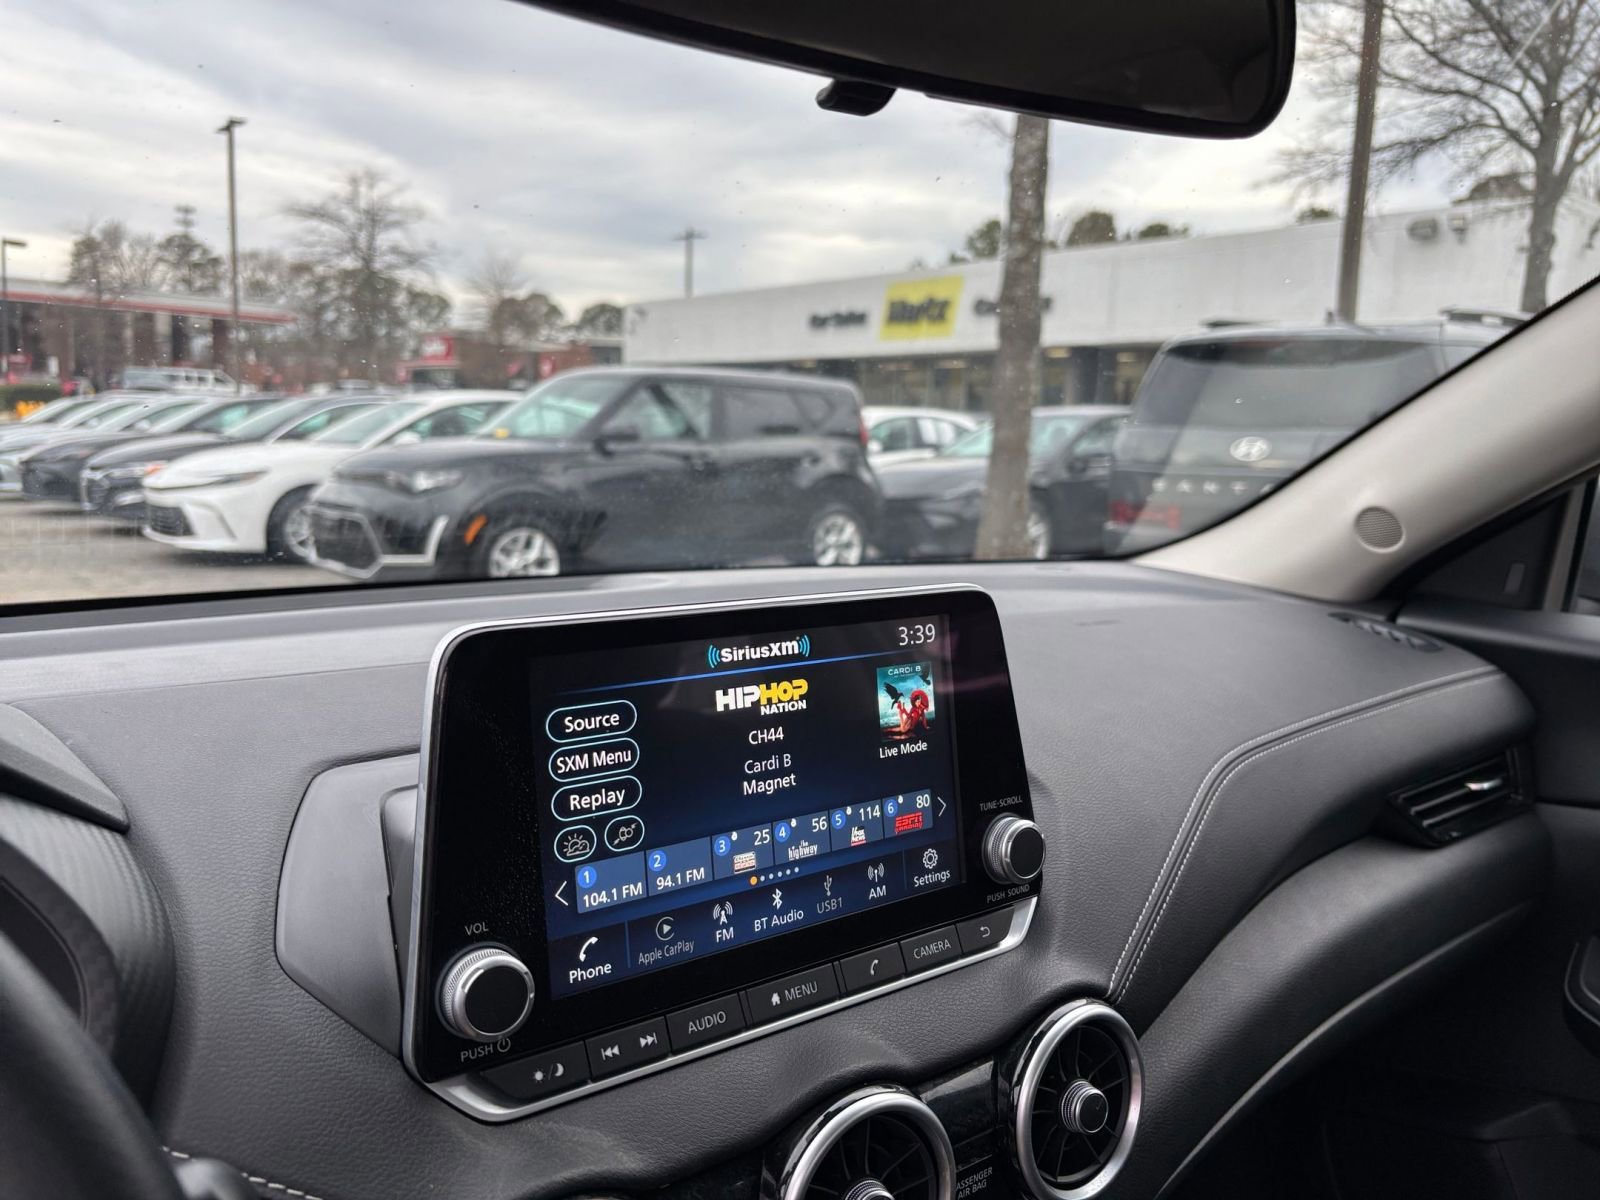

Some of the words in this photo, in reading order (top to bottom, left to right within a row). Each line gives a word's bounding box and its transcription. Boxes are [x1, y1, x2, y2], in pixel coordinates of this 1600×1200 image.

[886, 297, 952, 326] Hertz
[898, 623, 936, 646] 3:39
[887, 667, 913, 676] CARDI
[760, 699, 807, 716] NATION
[564, 712, 620, 733] Source
[748, 726, 784, 745] CH44
[880, 746, 898, 759] Live
[900, 740, 928, 755] Mode
[557, 753, 589, 774] SXM
[593, 749, 632, 768] Menu
[744, 754, 780, 774] Cardi
[783, 753, 792, 768] B
[743, 773, 796, 796] Magnet
[569, 788, 625, 811] Replay
[887, 802, 894, 814] 6
[916, 794, 930, 809] 80
[835, 814, 841, 826] 5
[859, 804, 881, 821] 114
[779, 826, 786, 838] 4
[812, 816, 828, 832] 56
[719, 840, 726, 853] 3
[753, 829, 770, 846] 25
[653, 854, 661, 868] 2
[788, 844, 818, 861] highway
[583, 870, 590, 884] 1
[656, 873, 682, 890] 94.1
[686, 867, 705, 882] FM
[913, 868, 951, 887] Settings
[583, 888, 618, 908] 104.1
[622, 882, 643, 899] FM
[868, 885, 887, 900] AM
[986, 892, 1006, 904] PUSH
[1007, 884, 1031, 897] SOUND
[816, 897, 843, 915] USB1
[464, 922, 489, 936] VOL
[754, 917, 768, 932] BT
[771, 908, 804, 927] Audio
[716, 927, 734, 943] FM
[638, 947, 662, 966] Apple
[664, 939, 695, 957] CarPlay
[913, 938, 952, 960] CAMERA
[569, 962, 612, 984] Phone
[784, 980, 818, 1001] MENU
[687, 1010, 727, 1034] AUDIO
[460, 1043, 494, 1063] PUSH
[956, 1166, 993, 1190] ASSENGER
[957, 1187, 971, 1200] AIR
[972, 1179, 987, 1193] BAG
